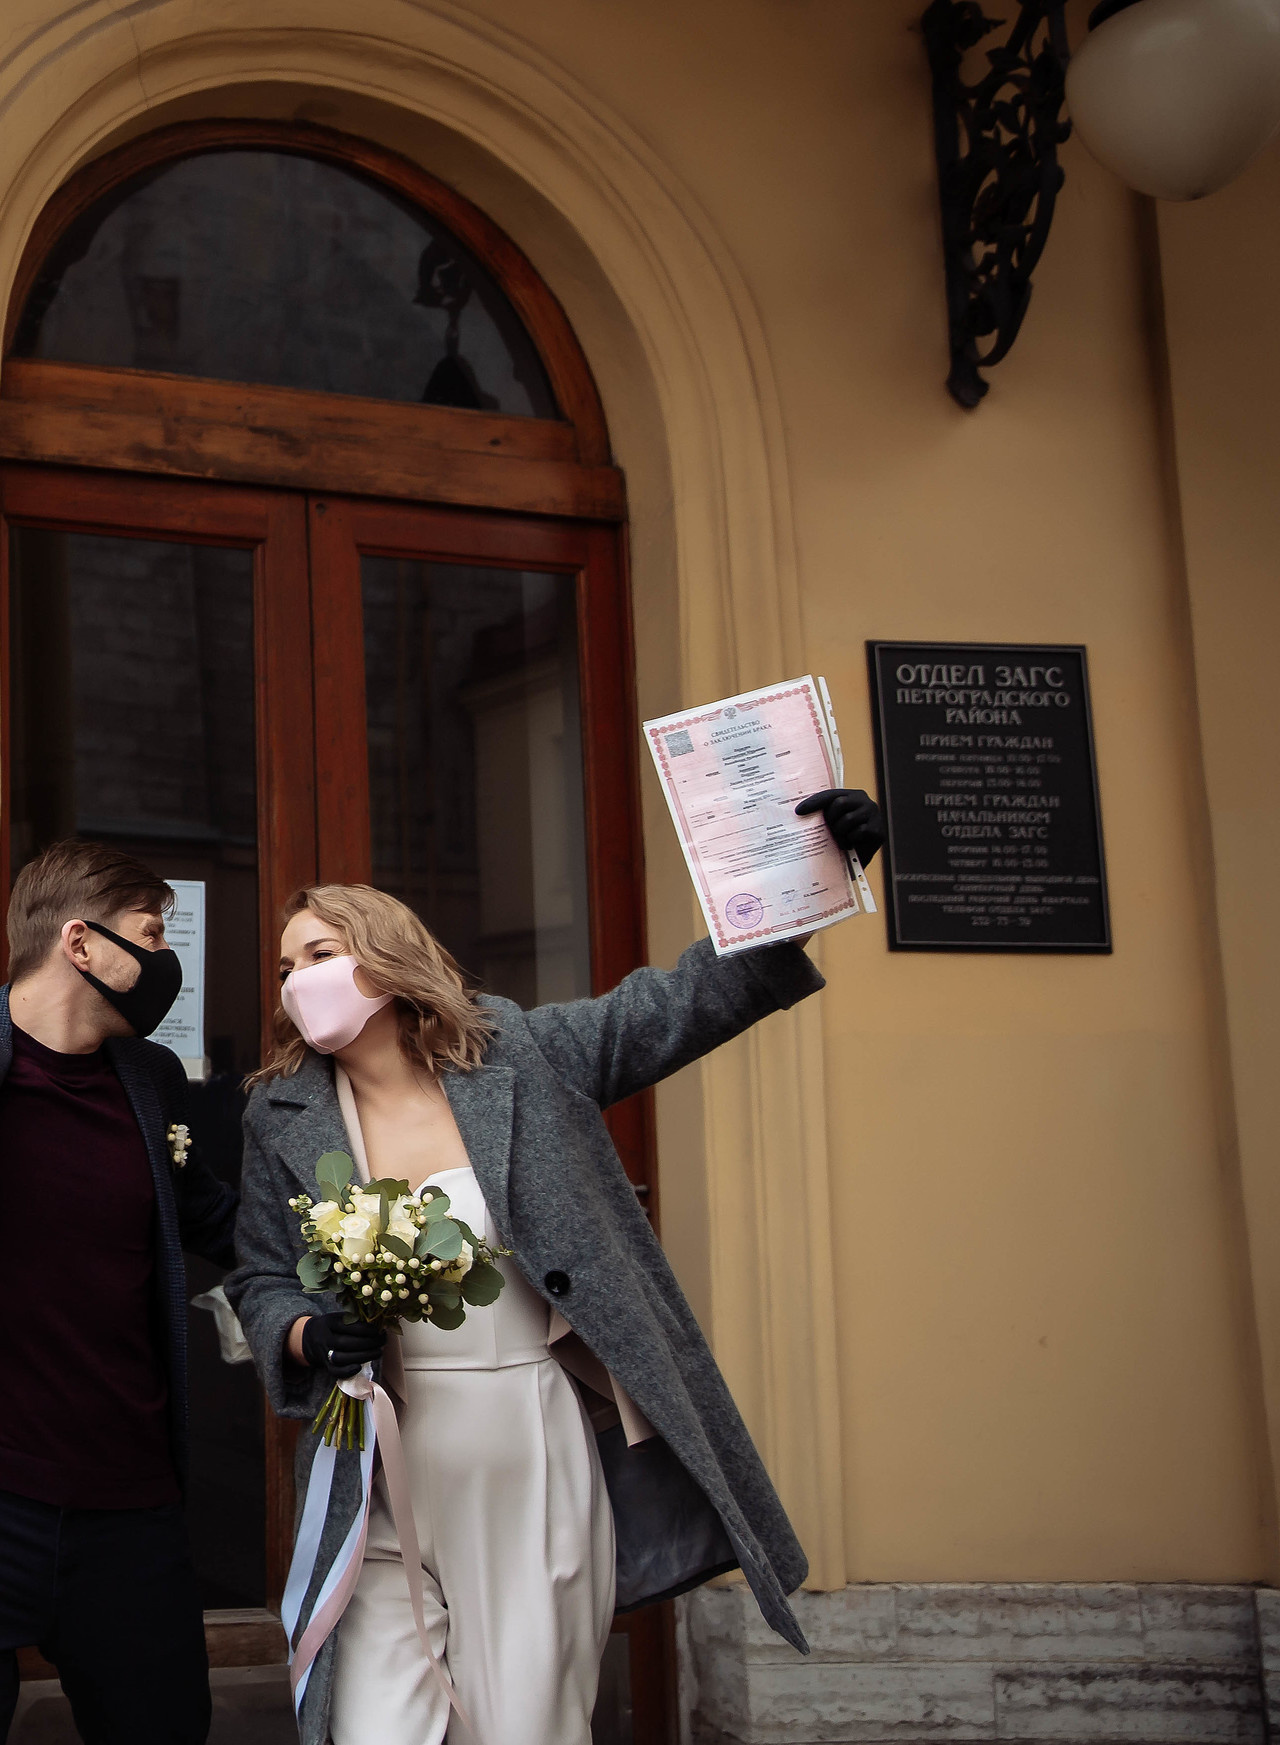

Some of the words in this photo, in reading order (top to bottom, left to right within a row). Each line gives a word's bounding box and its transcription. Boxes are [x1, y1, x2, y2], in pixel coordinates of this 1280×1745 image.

[896, 664, 985, 688] ОТДЕЛ
[995, 666, 1064, 688] ЗАГС
[896, 688, 1070, 708] ПЕТРОГРАДСКОГО
[945, 706, 1022, 726] РАЙОНА
[920, 734, 973, 748] ПРИЕМ
[977, 735, 1054, 750] ГРАЖДАН
[924, 793, 978, 807] ПРИЕМ
[983, 794, 1061, 809] ГРАЖДАН
[937, 810, 1052, 824] НАЧАЛЬНИКОМ
[941, 825, 1002, 839] ОТДЕЛА
[1009, 826, 1049, 839] ЗАГС
